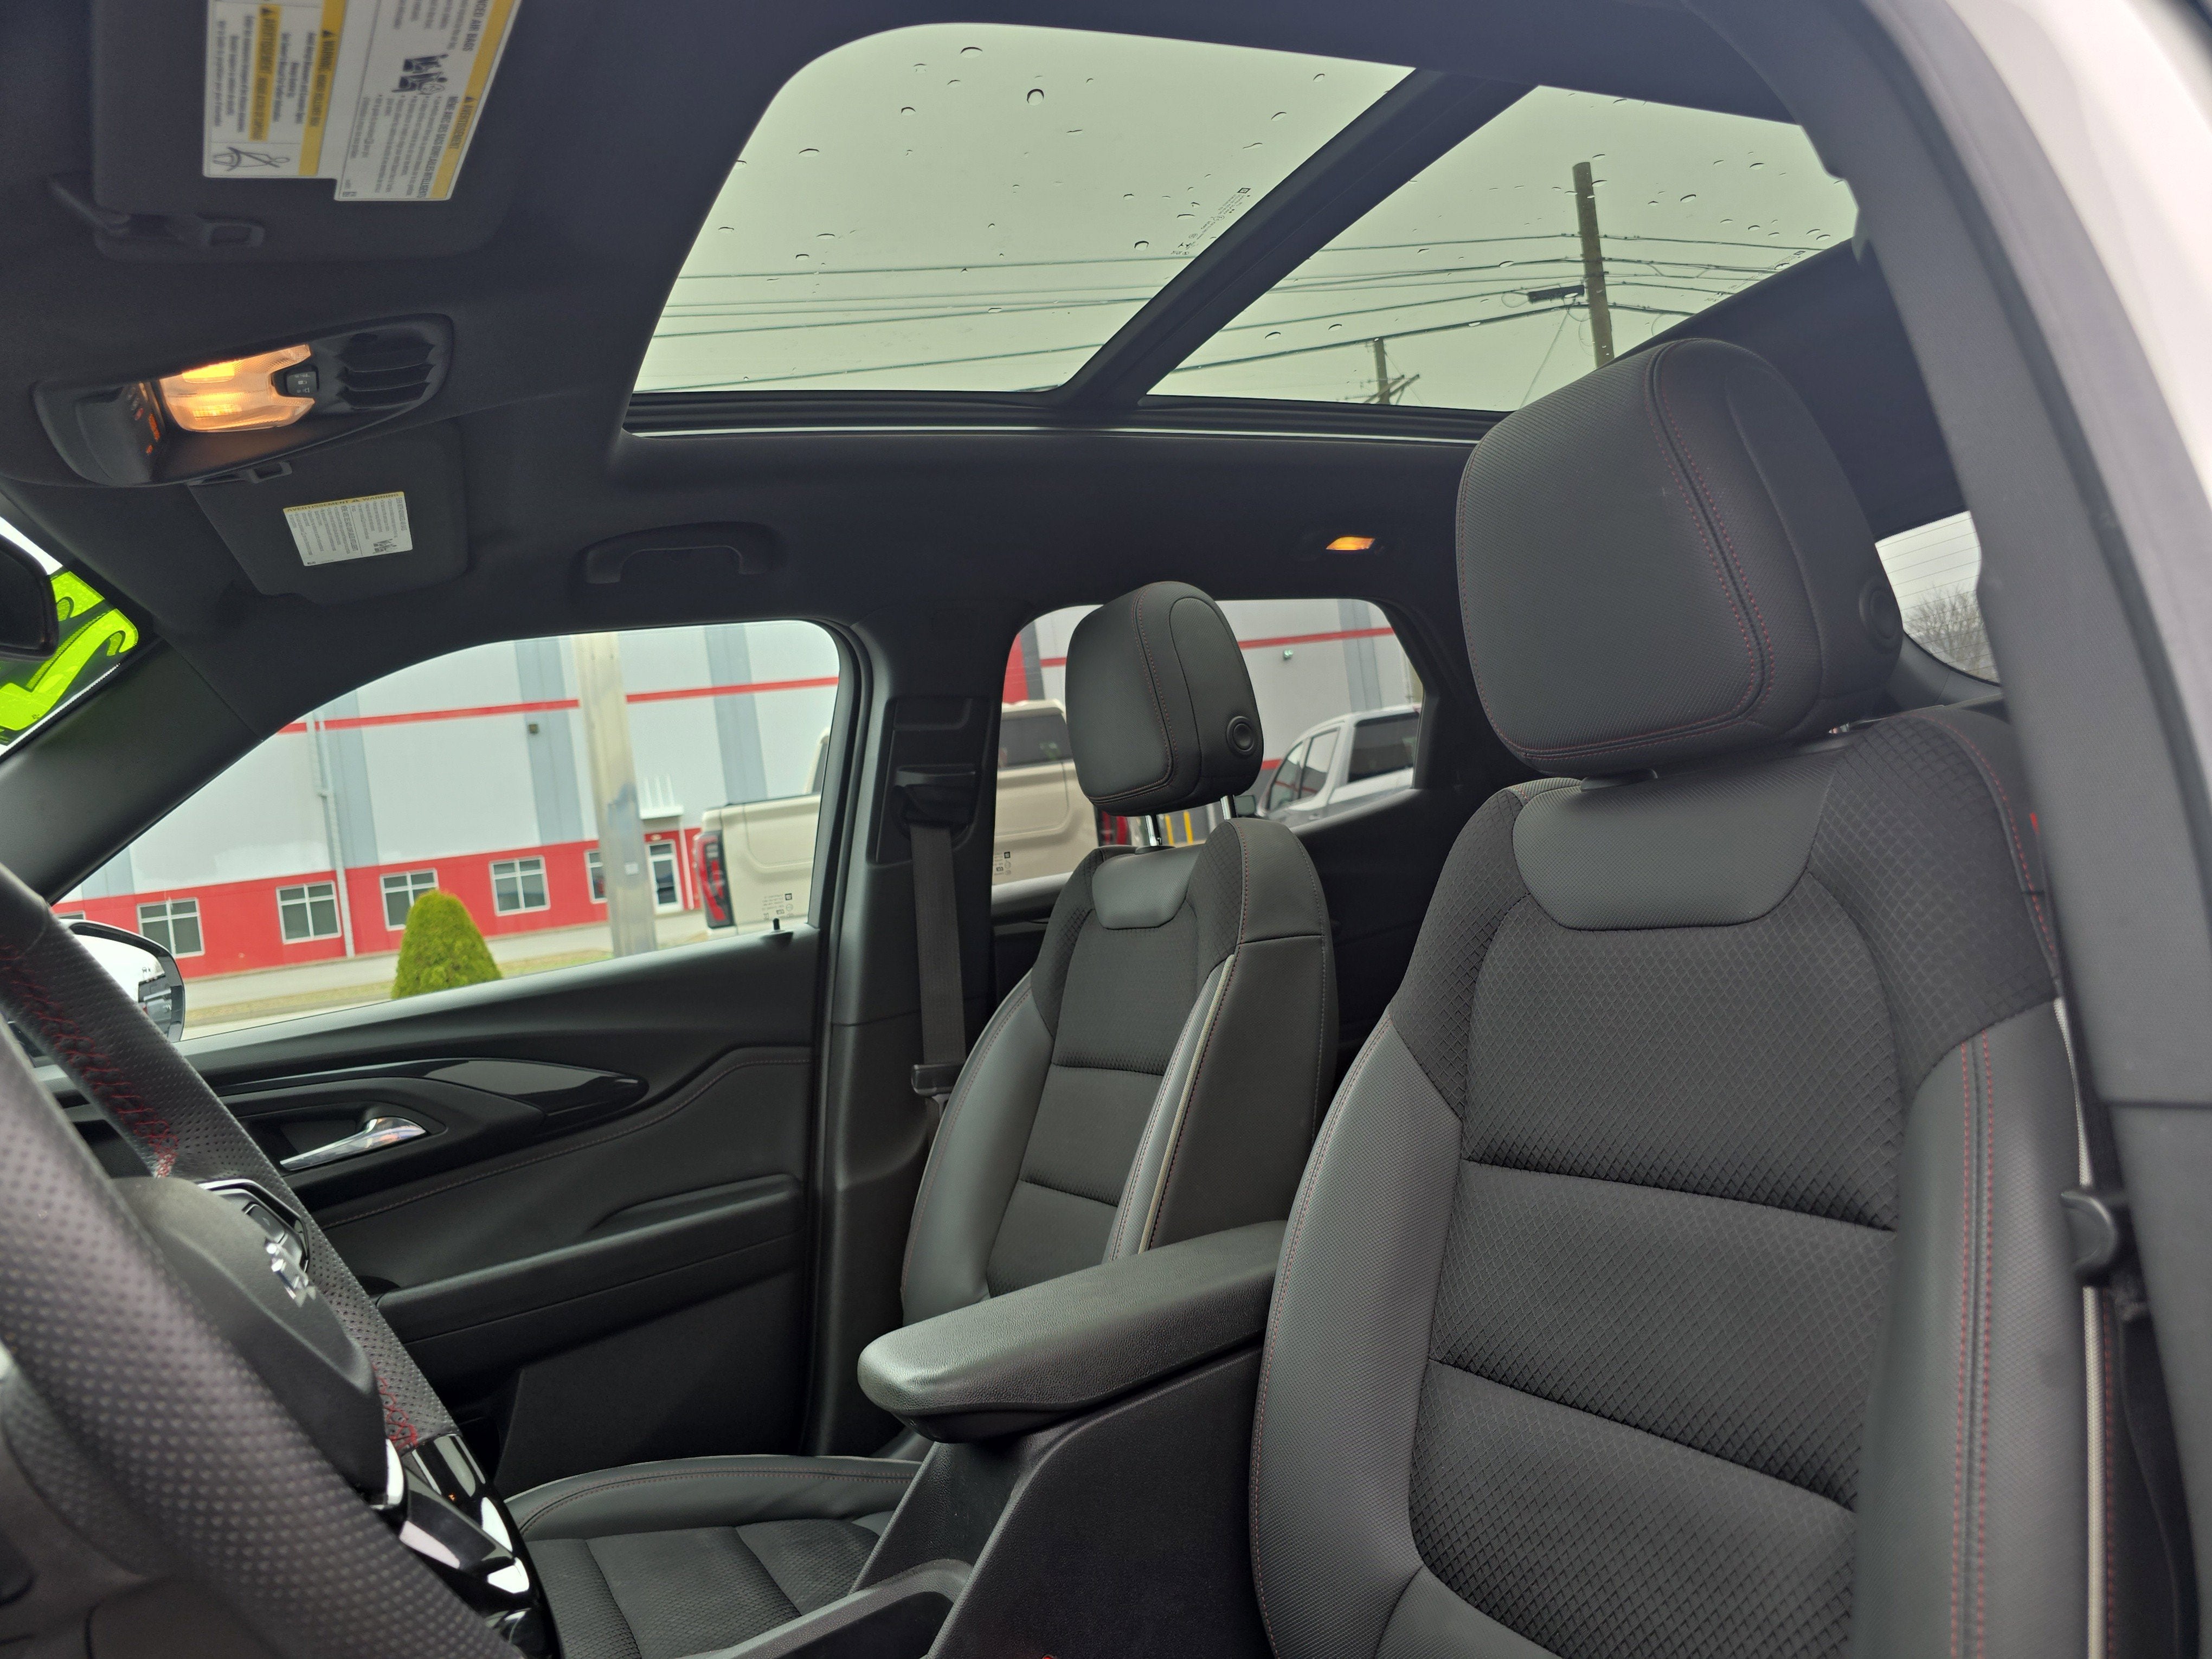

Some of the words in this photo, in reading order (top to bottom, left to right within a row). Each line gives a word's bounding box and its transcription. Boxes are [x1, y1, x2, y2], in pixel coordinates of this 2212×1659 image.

[468, 19, 483, 31] AIR
[461, 34, 478, 52] BAGS
[363, 493, 400, 502] WARNING
